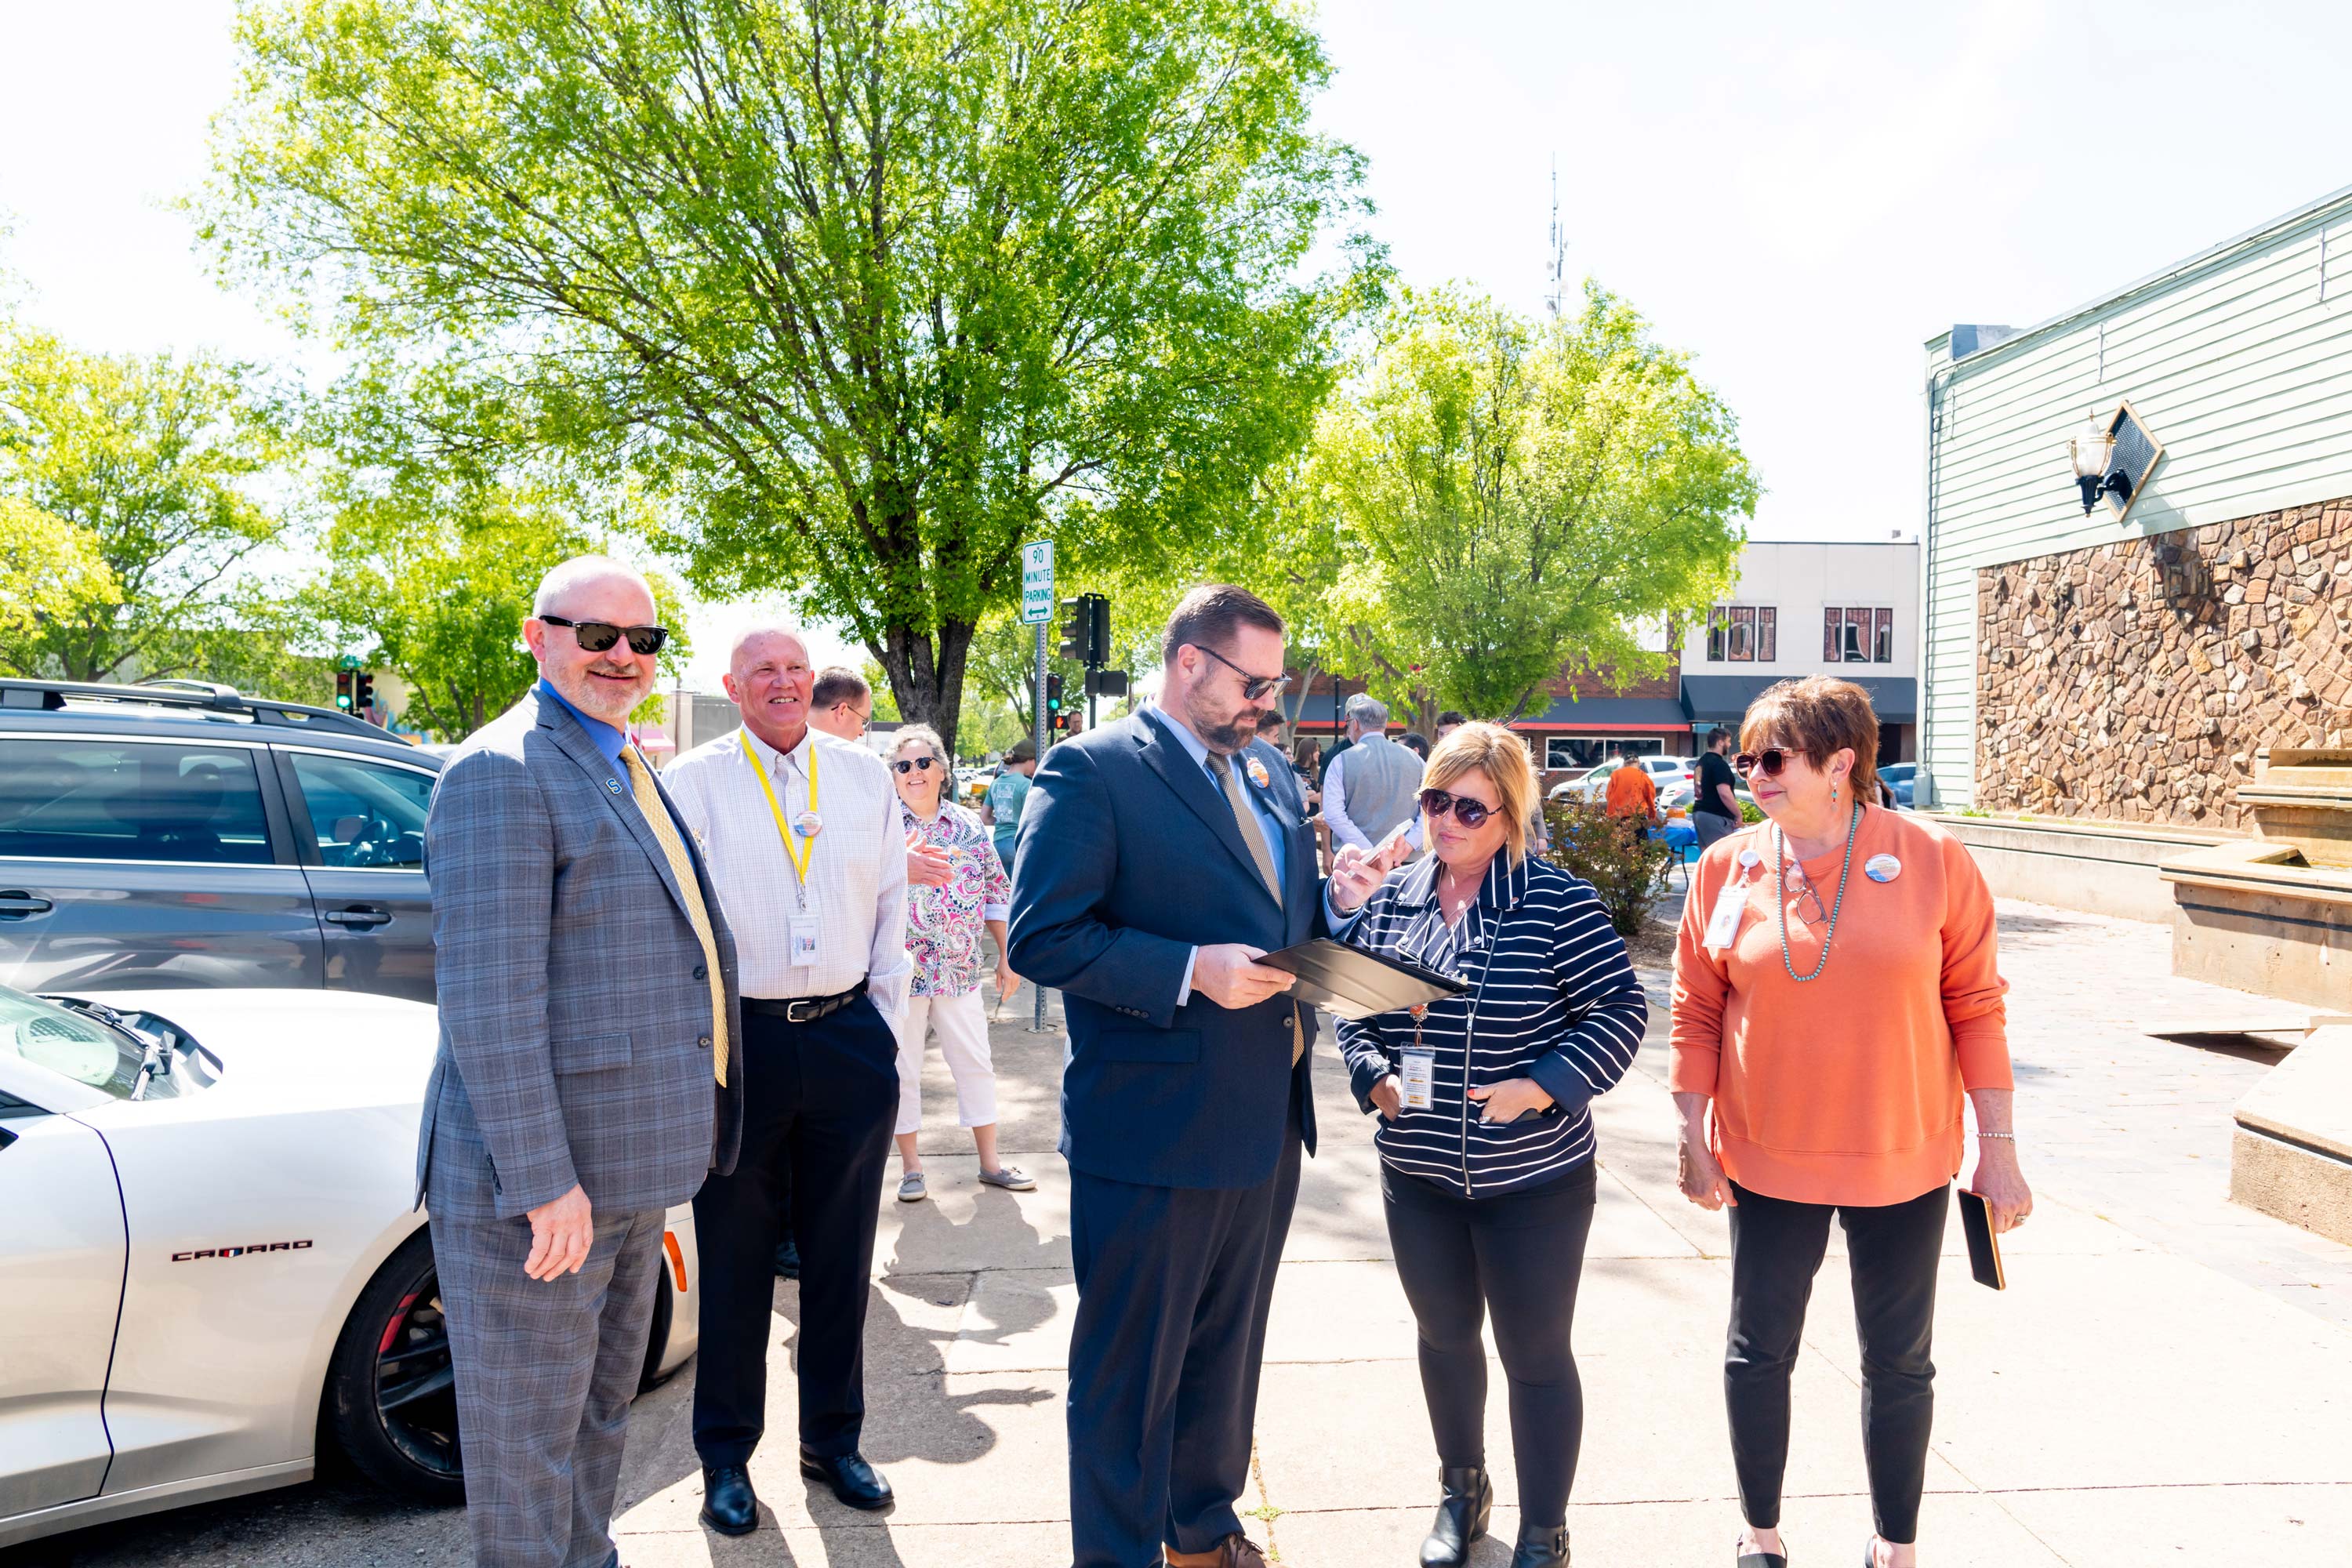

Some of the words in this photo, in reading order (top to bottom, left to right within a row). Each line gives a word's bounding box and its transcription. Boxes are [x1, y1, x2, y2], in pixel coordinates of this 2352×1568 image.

[1033, 549, 1044, 564] 90
[1025, 568, 1051, 583] MINUTE
[1025, 588, 1051, 603] PARKING
[606, 778, 622, 794] S
